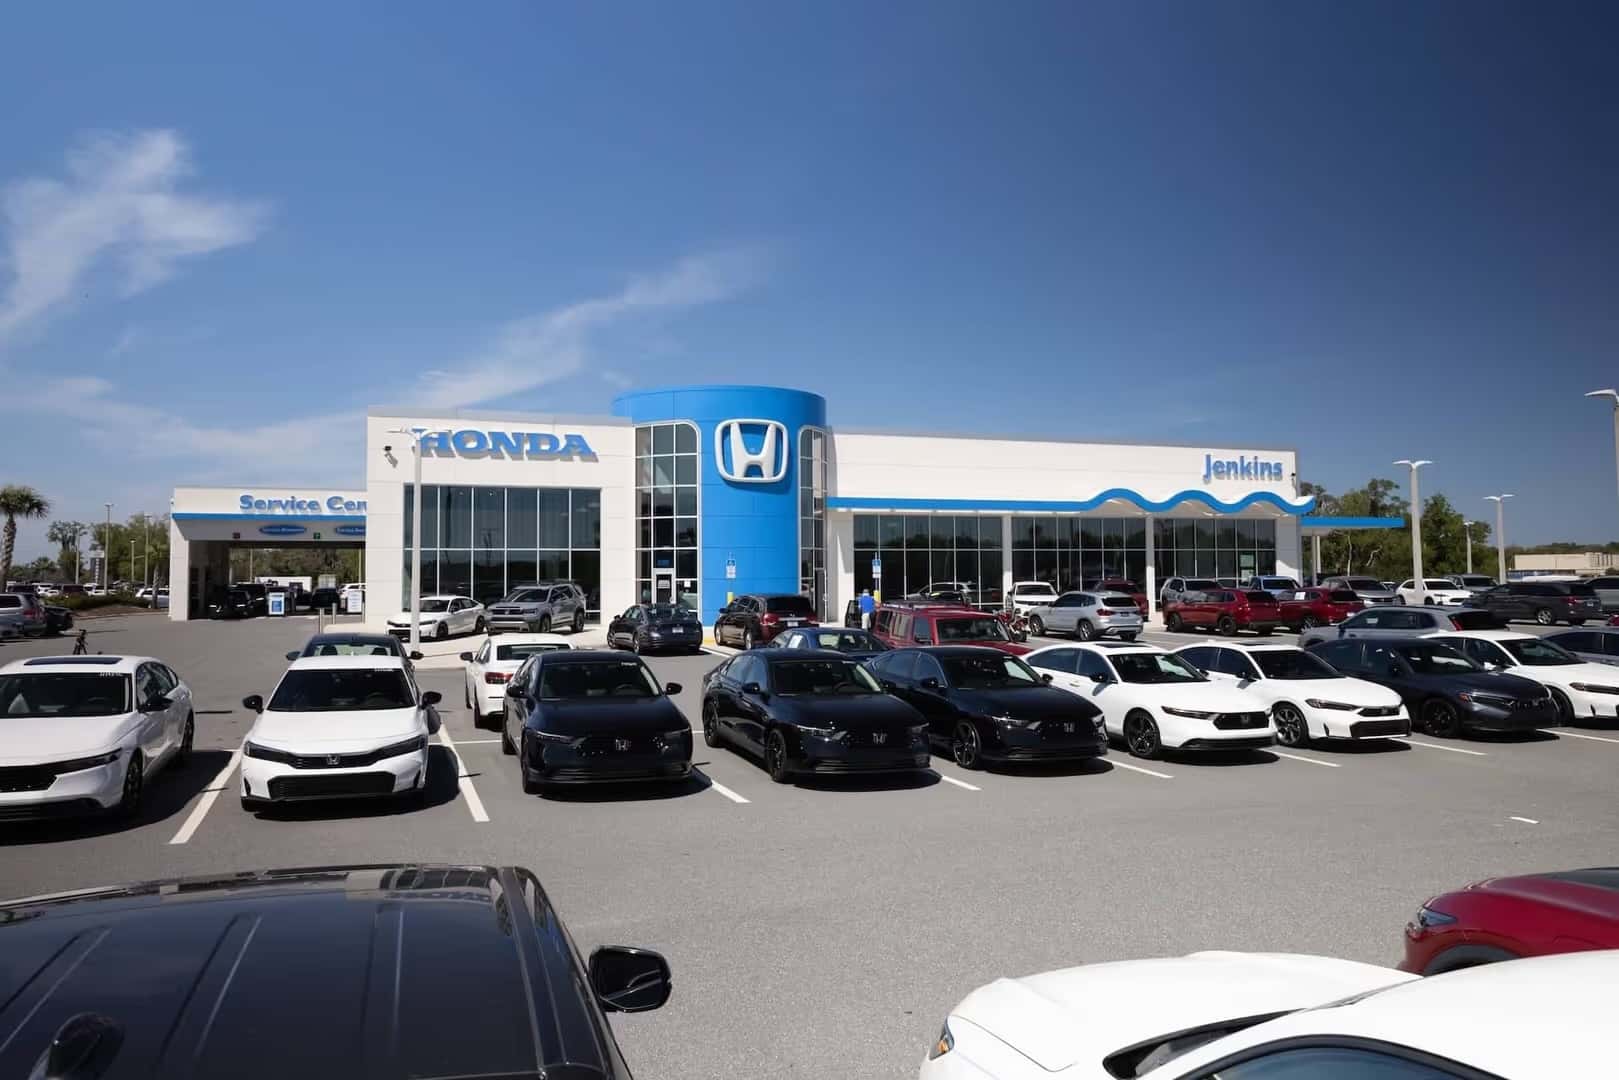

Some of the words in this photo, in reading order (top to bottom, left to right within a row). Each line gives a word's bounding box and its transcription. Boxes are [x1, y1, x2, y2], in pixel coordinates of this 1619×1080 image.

[412, 428, 596, 459] HONDA
[1203, 454, 1283, 480] Jenkins
[240, 495, 319, 510] Service
